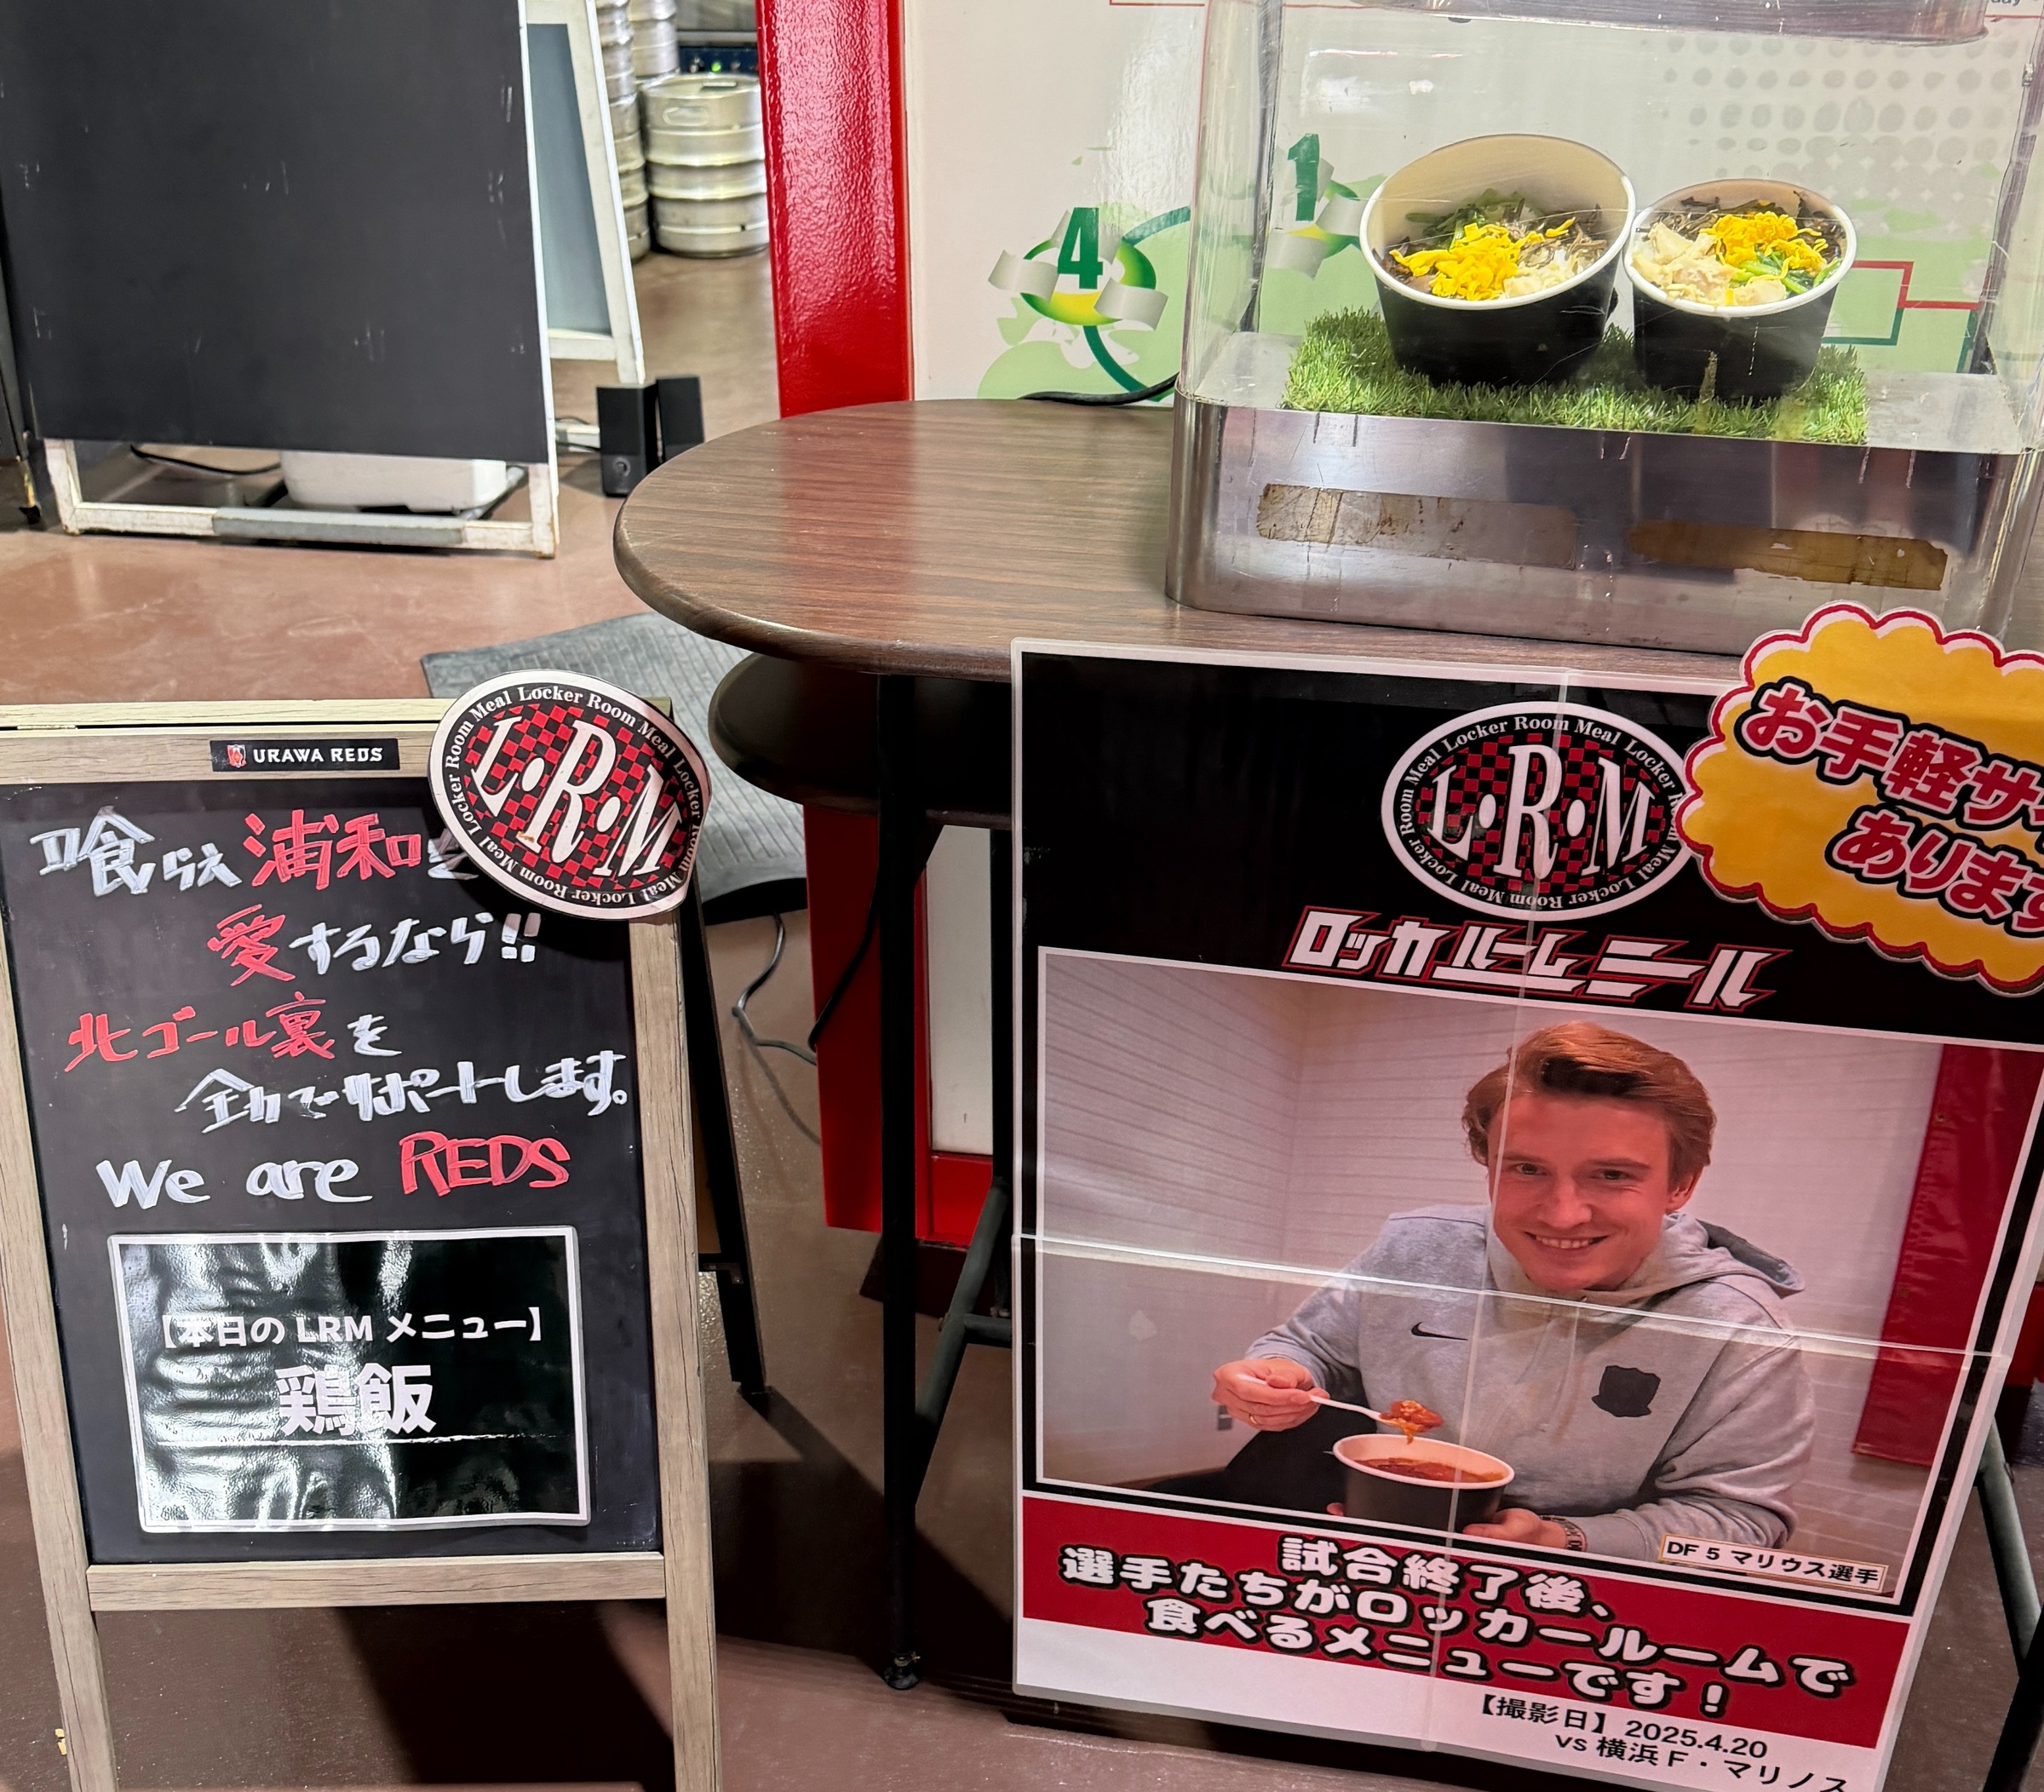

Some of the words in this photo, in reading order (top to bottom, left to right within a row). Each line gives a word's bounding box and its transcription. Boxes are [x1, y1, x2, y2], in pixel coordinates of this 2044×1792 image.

[1288, 133, 1321, 222] 1
[1057, 207, 1104, 290] 4
[468, 691, 513, 722] Meal
[518, 686, 583, 704] Locker
[588, 693, 636, 727] Room
[637, 721, 676, 760] Meal
[1441, 721, 1508, 752] Locker
[1513, 715, 1569, 731] Room
[1573, 718, 1622, 746] Meal
[253, 748, 324, 763] URAWA
[330, 747, 383, 762] REDS
[445, 722, 474, 769] Room
[1623, 739, 1676, 790] Locker
[1739, 678, 2044, 828] お手軽サ
[1404, 750, 1442, 787] Meal
[449, 773, 483, 836] Locker
[674, 759, 701, 818] Locker
[1398, 789, 1414, 837] Room
[478, 836, 519, 873] Meal
[1408, 838, 1458, 886] Locker
[1636, 844, 1677, 881] Meal
[520, 867, 568, 899] Room
[571, 889, 635, 906] Locker
[640, 871, 682, 901] Meal
[1460, 880, 1505, 905] Meal
[1510, 893, 1563, 909] Room
[1569, 869, 1636, 905] Locker
[95, 1159, 211, 1209] We
[245, 1159, 373, 1203] are
[399, 1131, 570, 1196] REDS
[297, 1315, 374, 1343] LRM
[274, 1363, 437, 1436] 鶏飯
[1280, 1536, 1613, 1620] 試合終了後、
[1667, 1541, 1699, 1557] DF
[1706, 1547, 1720, 1560] 5
[1731, 1549, 1879, 1585] マリウス選手
[1061, 1546, 1853, 1694] 選手たちがロッカールームで
[1146, 1597, 1727, 1714] 食べるメニューです！
[1626, 1720, 1768, 1759] 2025.4.20
